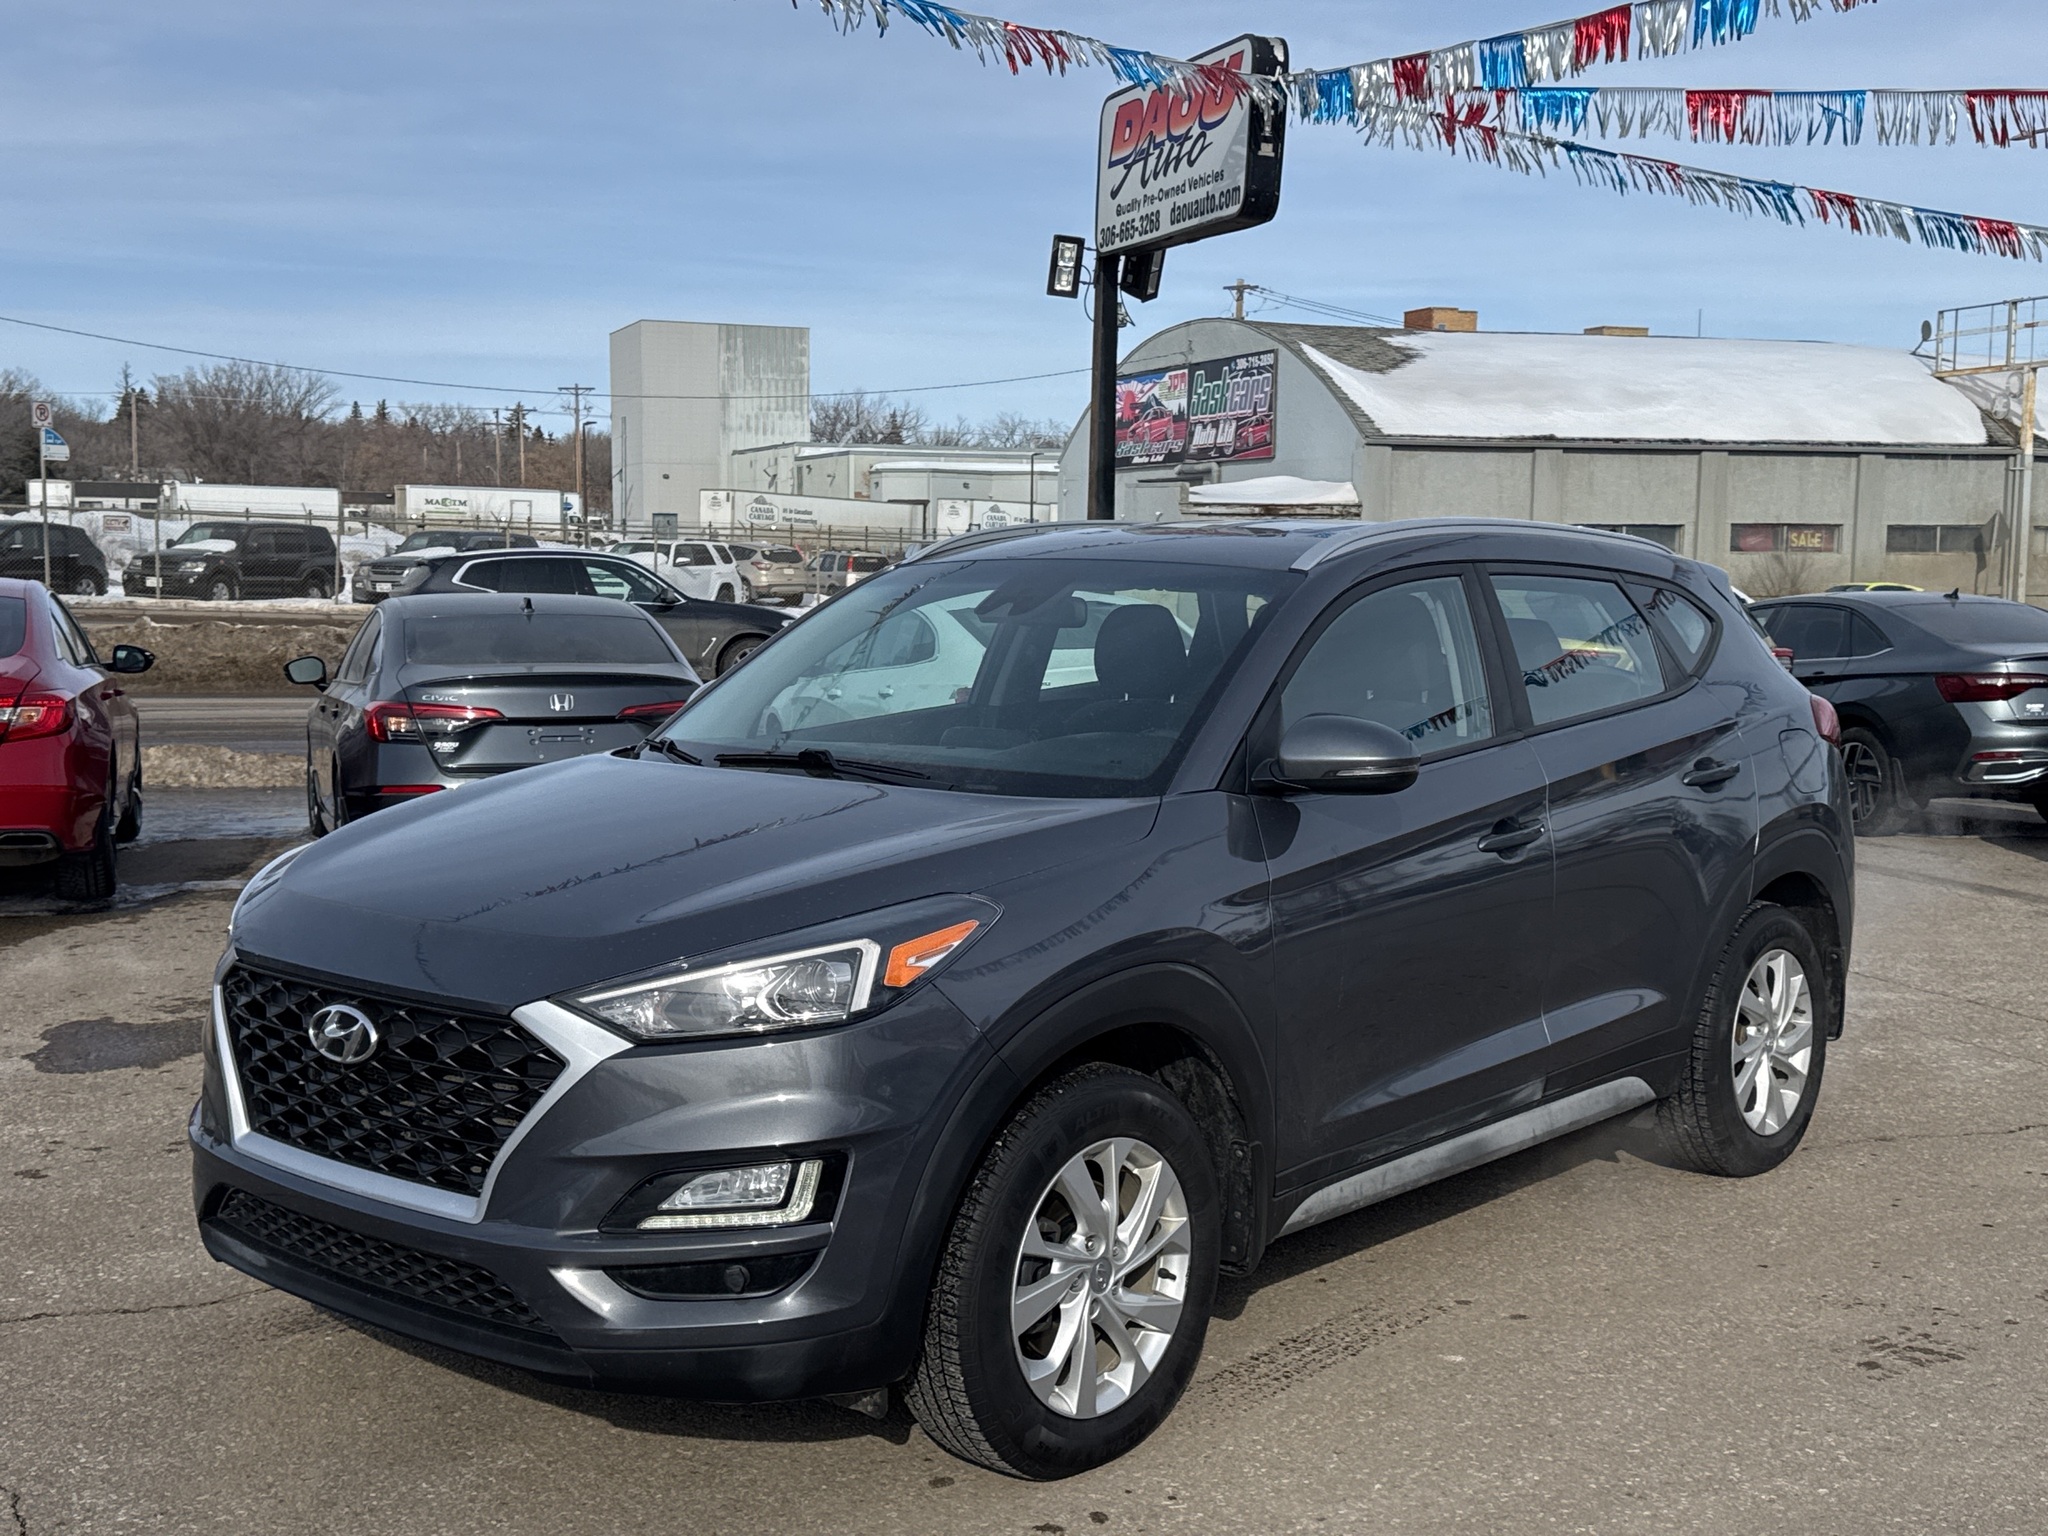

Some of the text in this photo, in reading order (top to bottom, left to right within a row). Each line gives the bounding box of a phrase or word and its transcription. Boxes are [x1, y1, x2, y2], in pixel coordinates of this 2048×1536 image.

[1108, 50, 1245, 168] DAOU
[1110, 125, 1213, 200] Auto
[1116, 169, 1225, 217] Quality Pre-Owned Vehicles
[1100, 184, 1241, 248] 306-665-3268 daouauto.com
[1191, 422, 1217, 449] Auto
[749, 513, 775, 521] CARTAGE
[750, 506, 774, 514] CANADA
[1791, 533, 1822, 547] SALE
